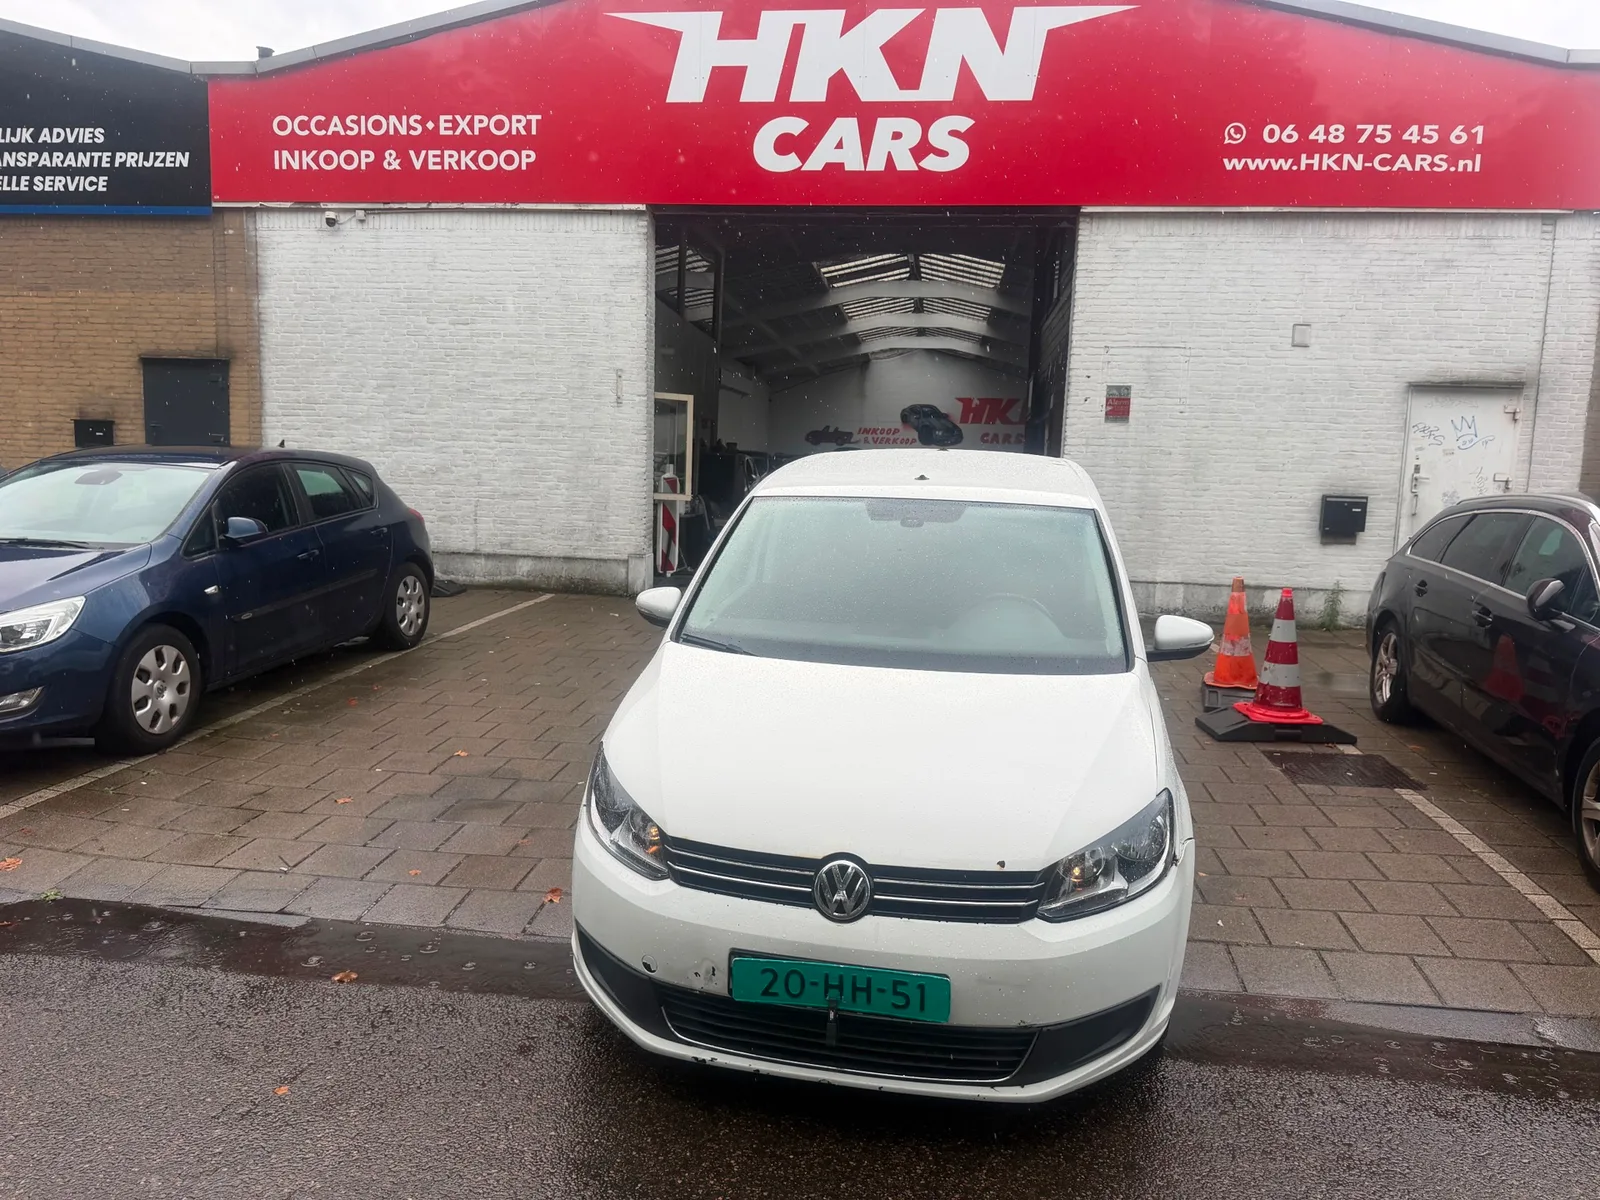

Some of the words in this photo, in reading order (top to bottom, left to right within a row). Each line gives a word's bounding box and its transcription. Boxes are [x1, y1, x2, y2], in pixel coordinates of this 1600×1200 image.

[602, 5, 1140, 103] HKN
[272, 114, 423, 136] OCCASIONS
[439, 114, 542, 136] EXPORT
[1262, 124, 1299, 144] 06
[1308, 124, 1345, 144] 48
[1356, 124, 1392, 144] 75
[1402, 124, 1439, 144] 45
[1449, 124, 1484, 145] 61
[37, 127, 105, 144] ADVIES
[752, 115, 976, 173] CARS
[0, 151, 111, 168] NSPARANTE
[114, 151, 190, 168] PRIJZEN
[273, 149, 375, 171] INKOOP
[382, 149, 402, 171] &
[408, 149, 536, 171] VERKOOP
[1222, 153, 1482, 172] www.HKN-CARS.nl
[32, 175, 108, 192] SERVICE
[857, 426, 901, 436] INKOOP
[872, 436, 918, 445] VERKOOP
[759, 967, 927, 1013] 20-HH-51
